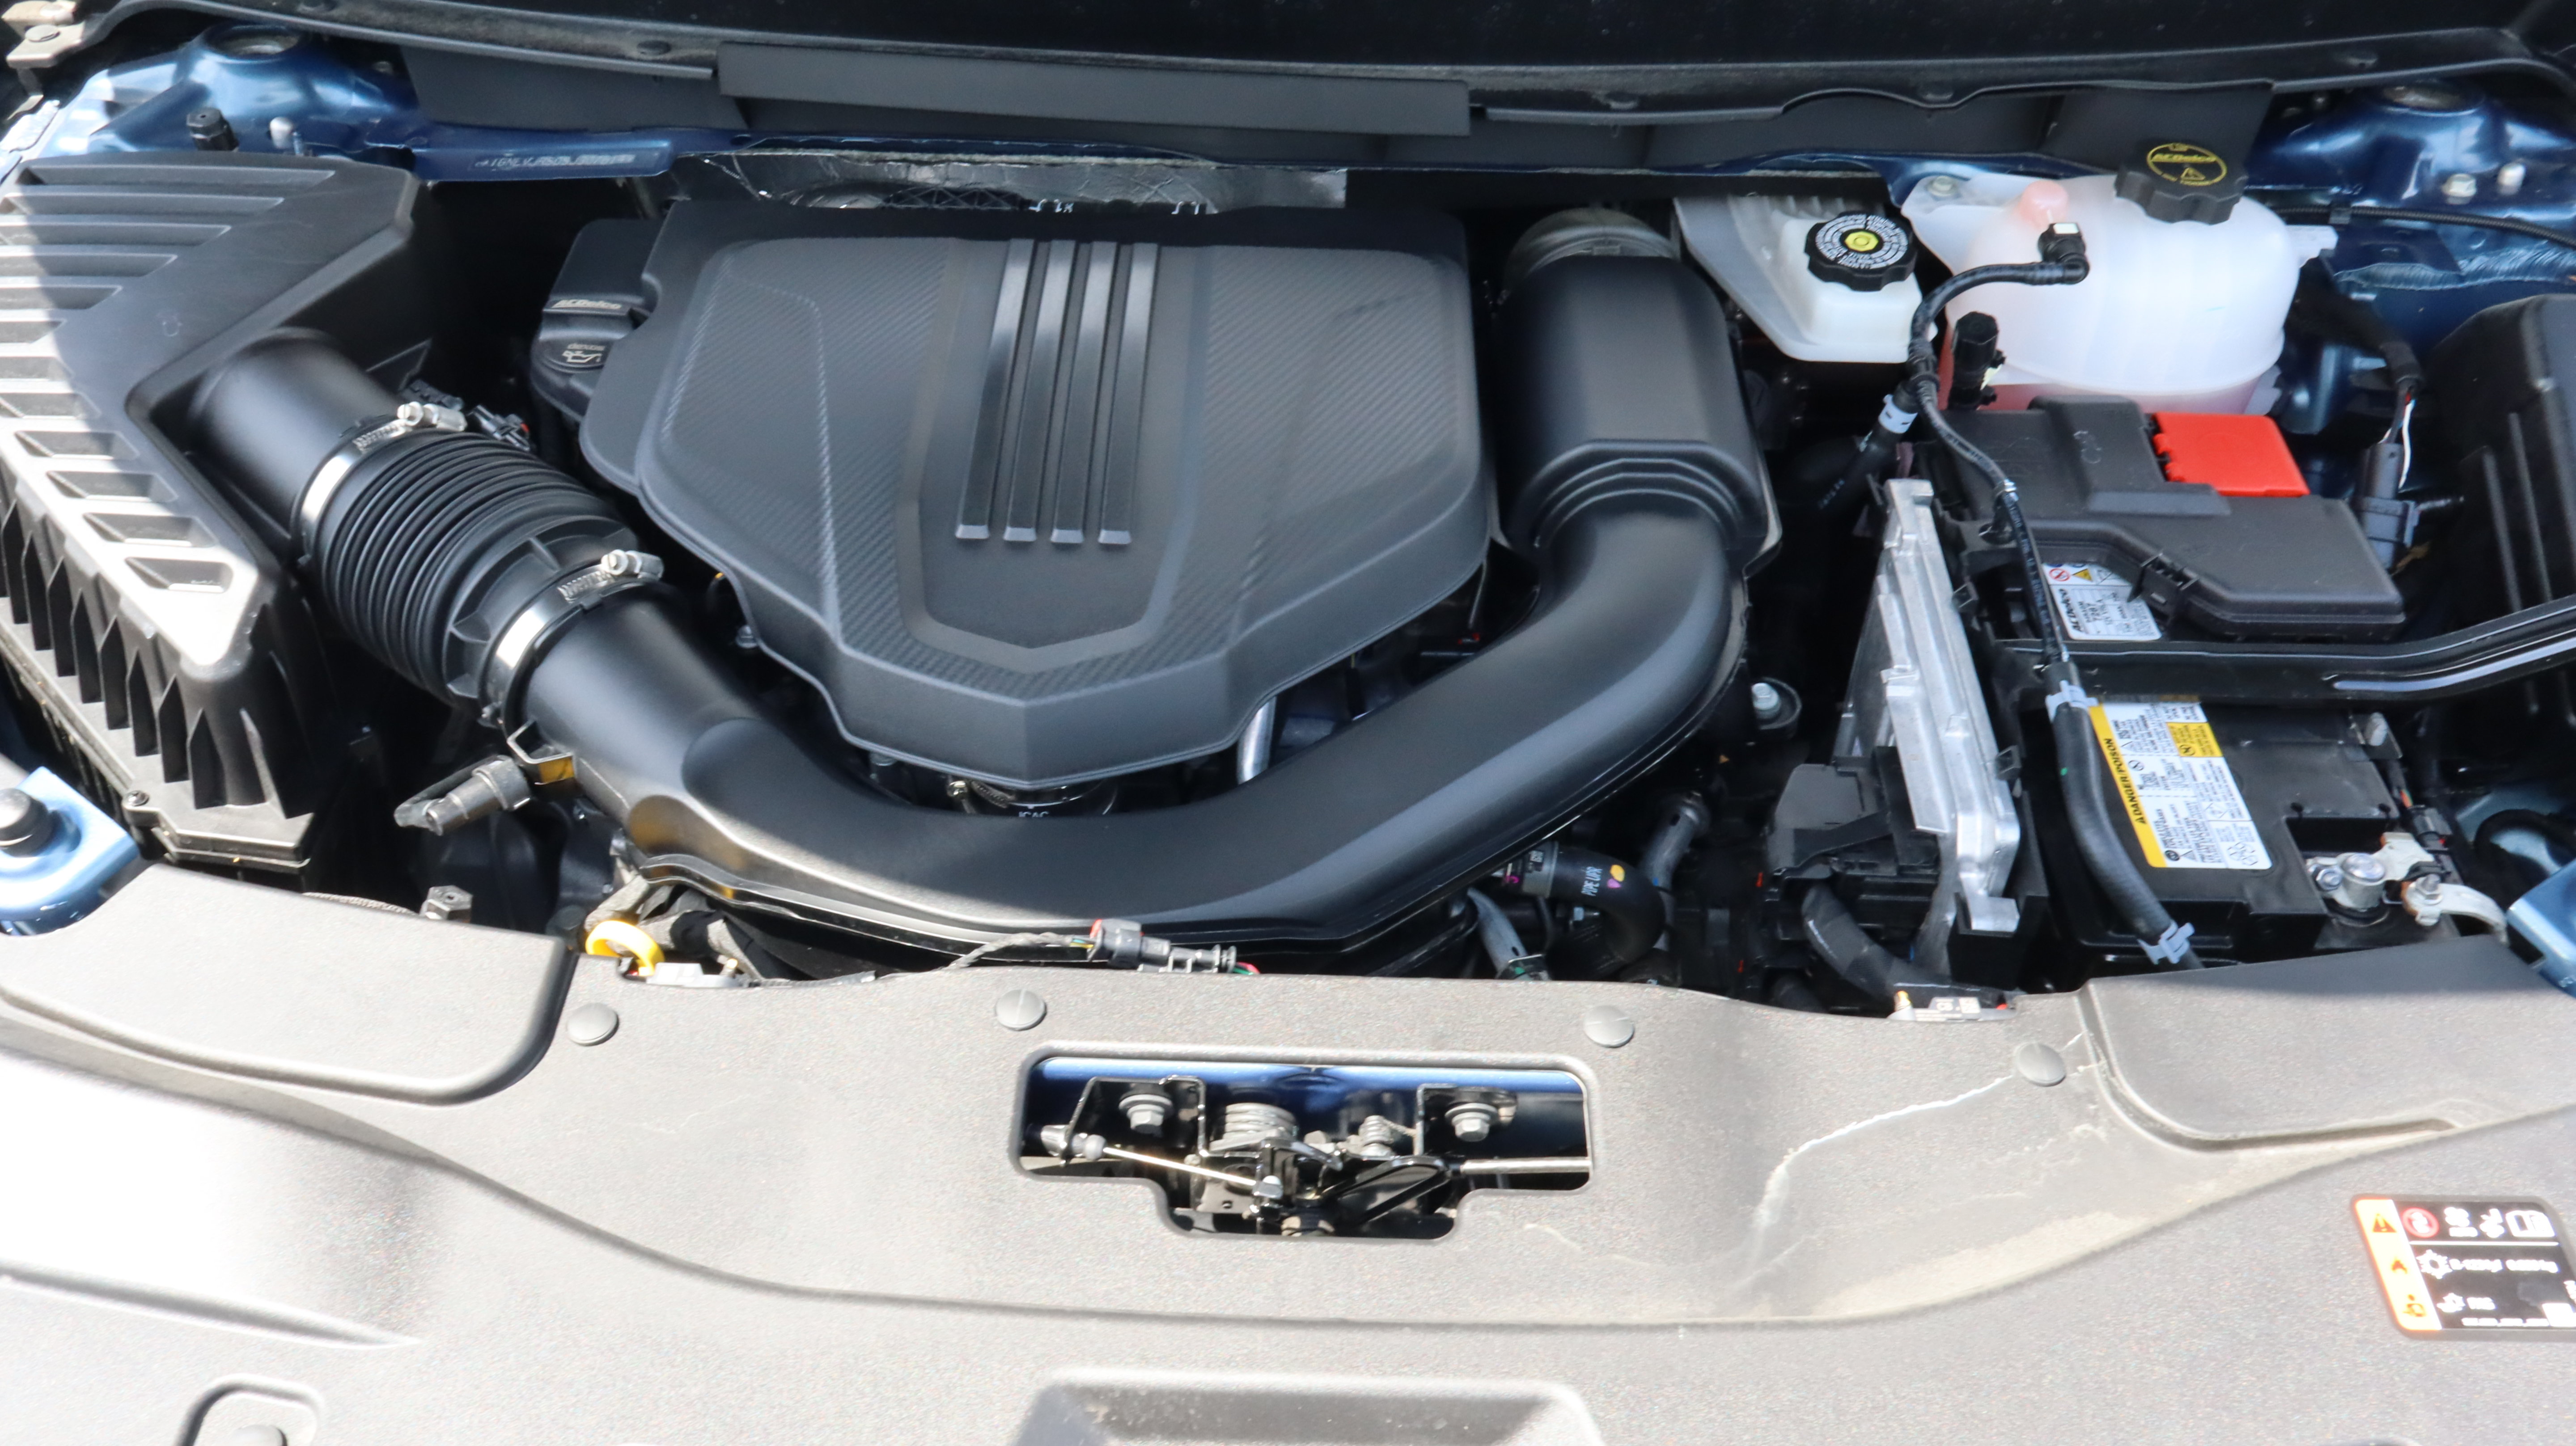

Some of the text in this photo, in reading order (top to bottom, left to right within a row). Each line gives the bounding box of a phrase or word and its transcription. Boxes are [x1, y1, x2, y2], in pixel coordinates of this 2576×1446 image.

[551, 299, 622, 310] ACDelco
[2059, 589, 2082, 632] ACDelco
[2104, 738, 2141, 815] DANGER/POISON
[1581, 881, 1599, 896] PIPE
